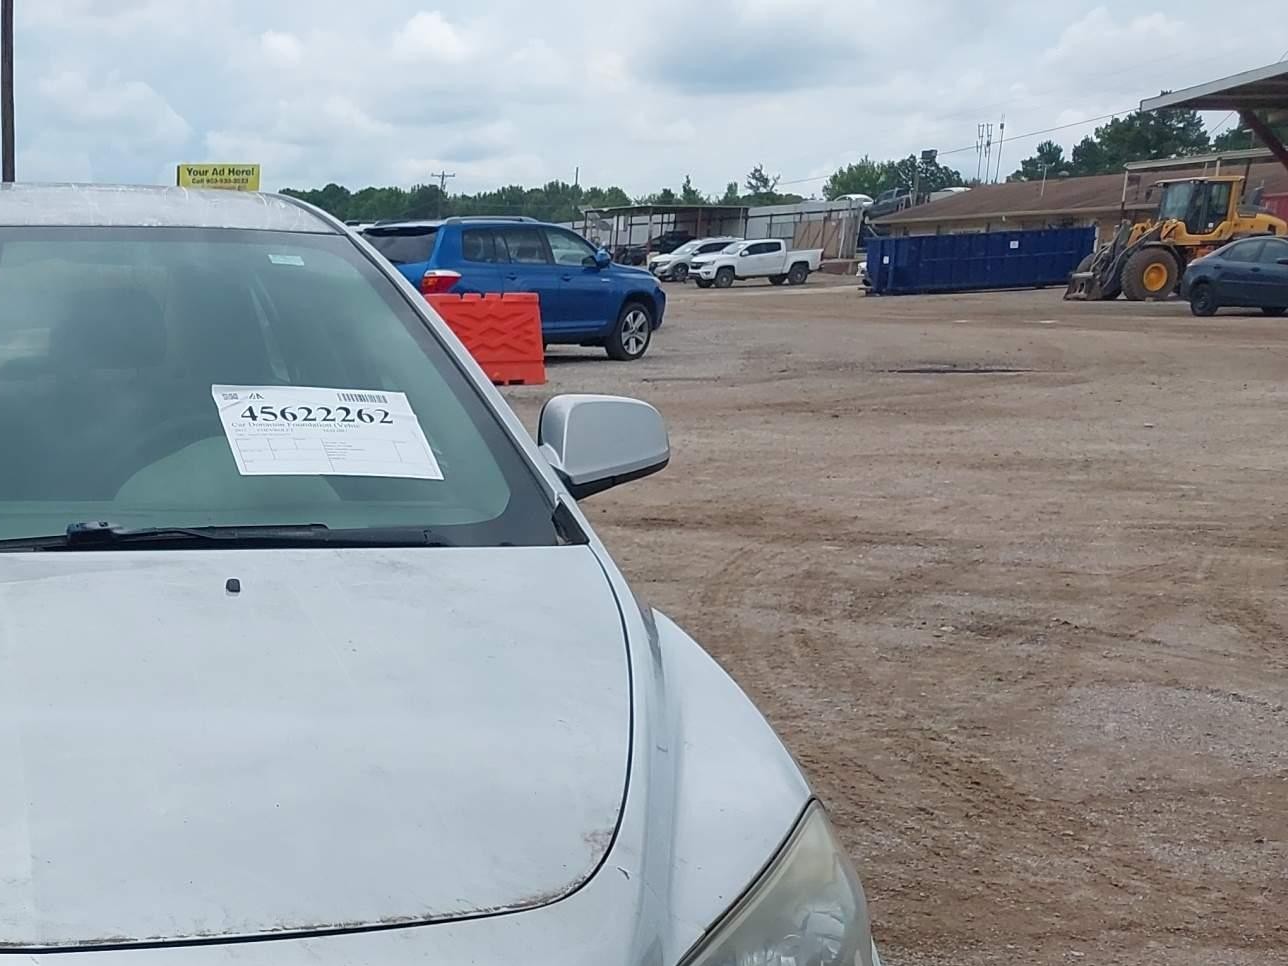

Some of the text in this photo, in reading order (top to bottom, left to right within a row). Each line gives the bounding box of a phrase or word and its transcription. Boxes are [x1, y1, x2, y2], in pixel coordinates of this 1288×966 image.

[186, 167, 255, 176] Your Ad Here!
[241, 405, 394, 424] 45622262
